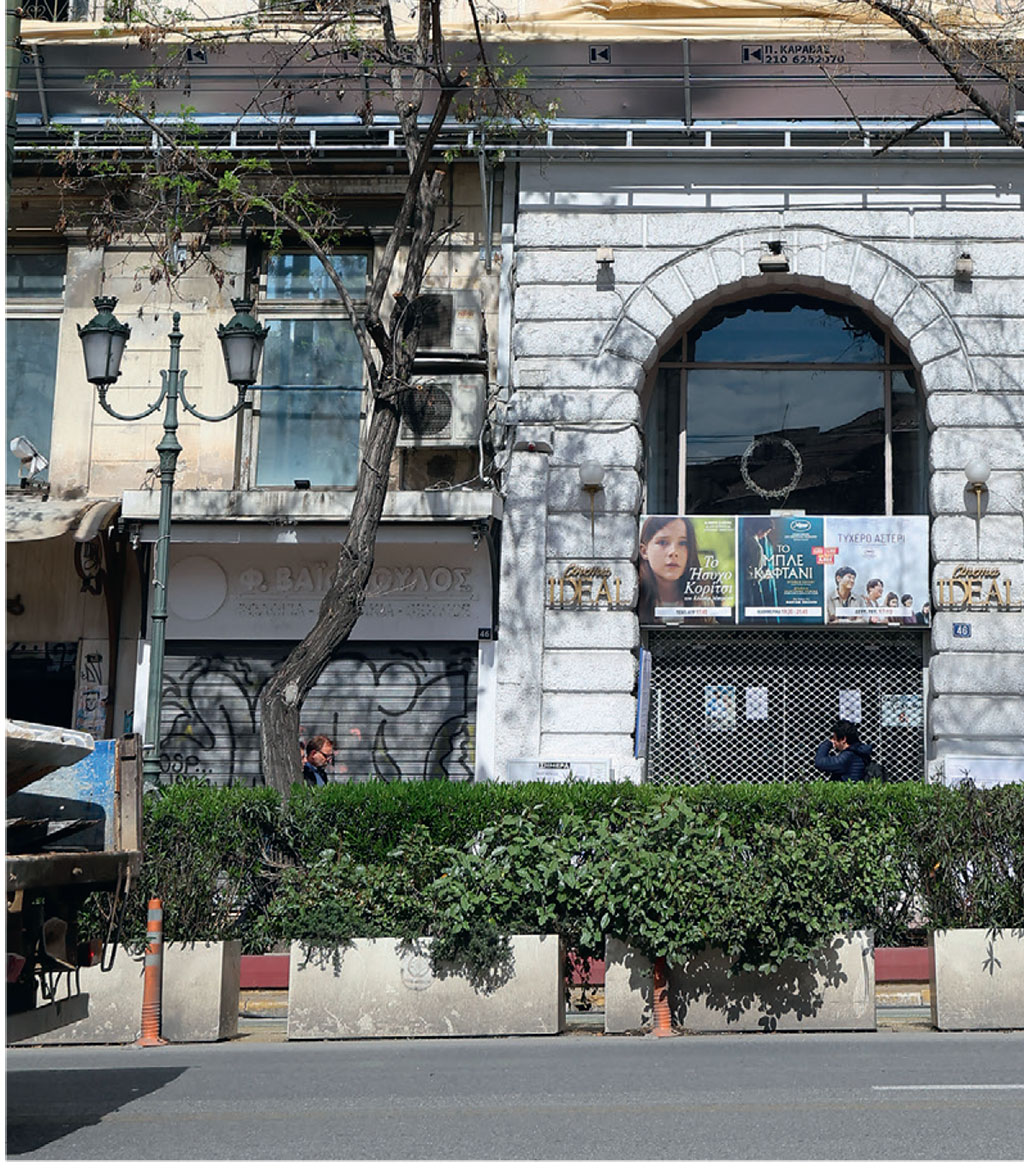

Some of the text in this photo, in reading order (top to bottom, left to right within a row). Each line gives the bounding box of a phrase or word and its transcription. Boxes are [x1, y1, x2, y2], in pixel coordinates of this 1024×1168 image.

[765, 55, 788, 64] 210
[838, 533, 906, 544] ΤΥΧΕΡΟ ΑΣΤΕΡΙ
[776, 544, 791, 553] ΤΟ
[704, 555, 720, 569] Το
[762, 554, 804, 567] ΜΠΛΕ
[689, 567, 733, 584] Ήσυχο
[754, 567, 813, 580] ΚΑΦΤΑΝΙ
[548, 576, 631, 606] IDEAL
[684, 581, 733, 597] Κορίτσι
[937, 578, 1022, 607] IDEAL
[955, 625, 969, 635] 46
